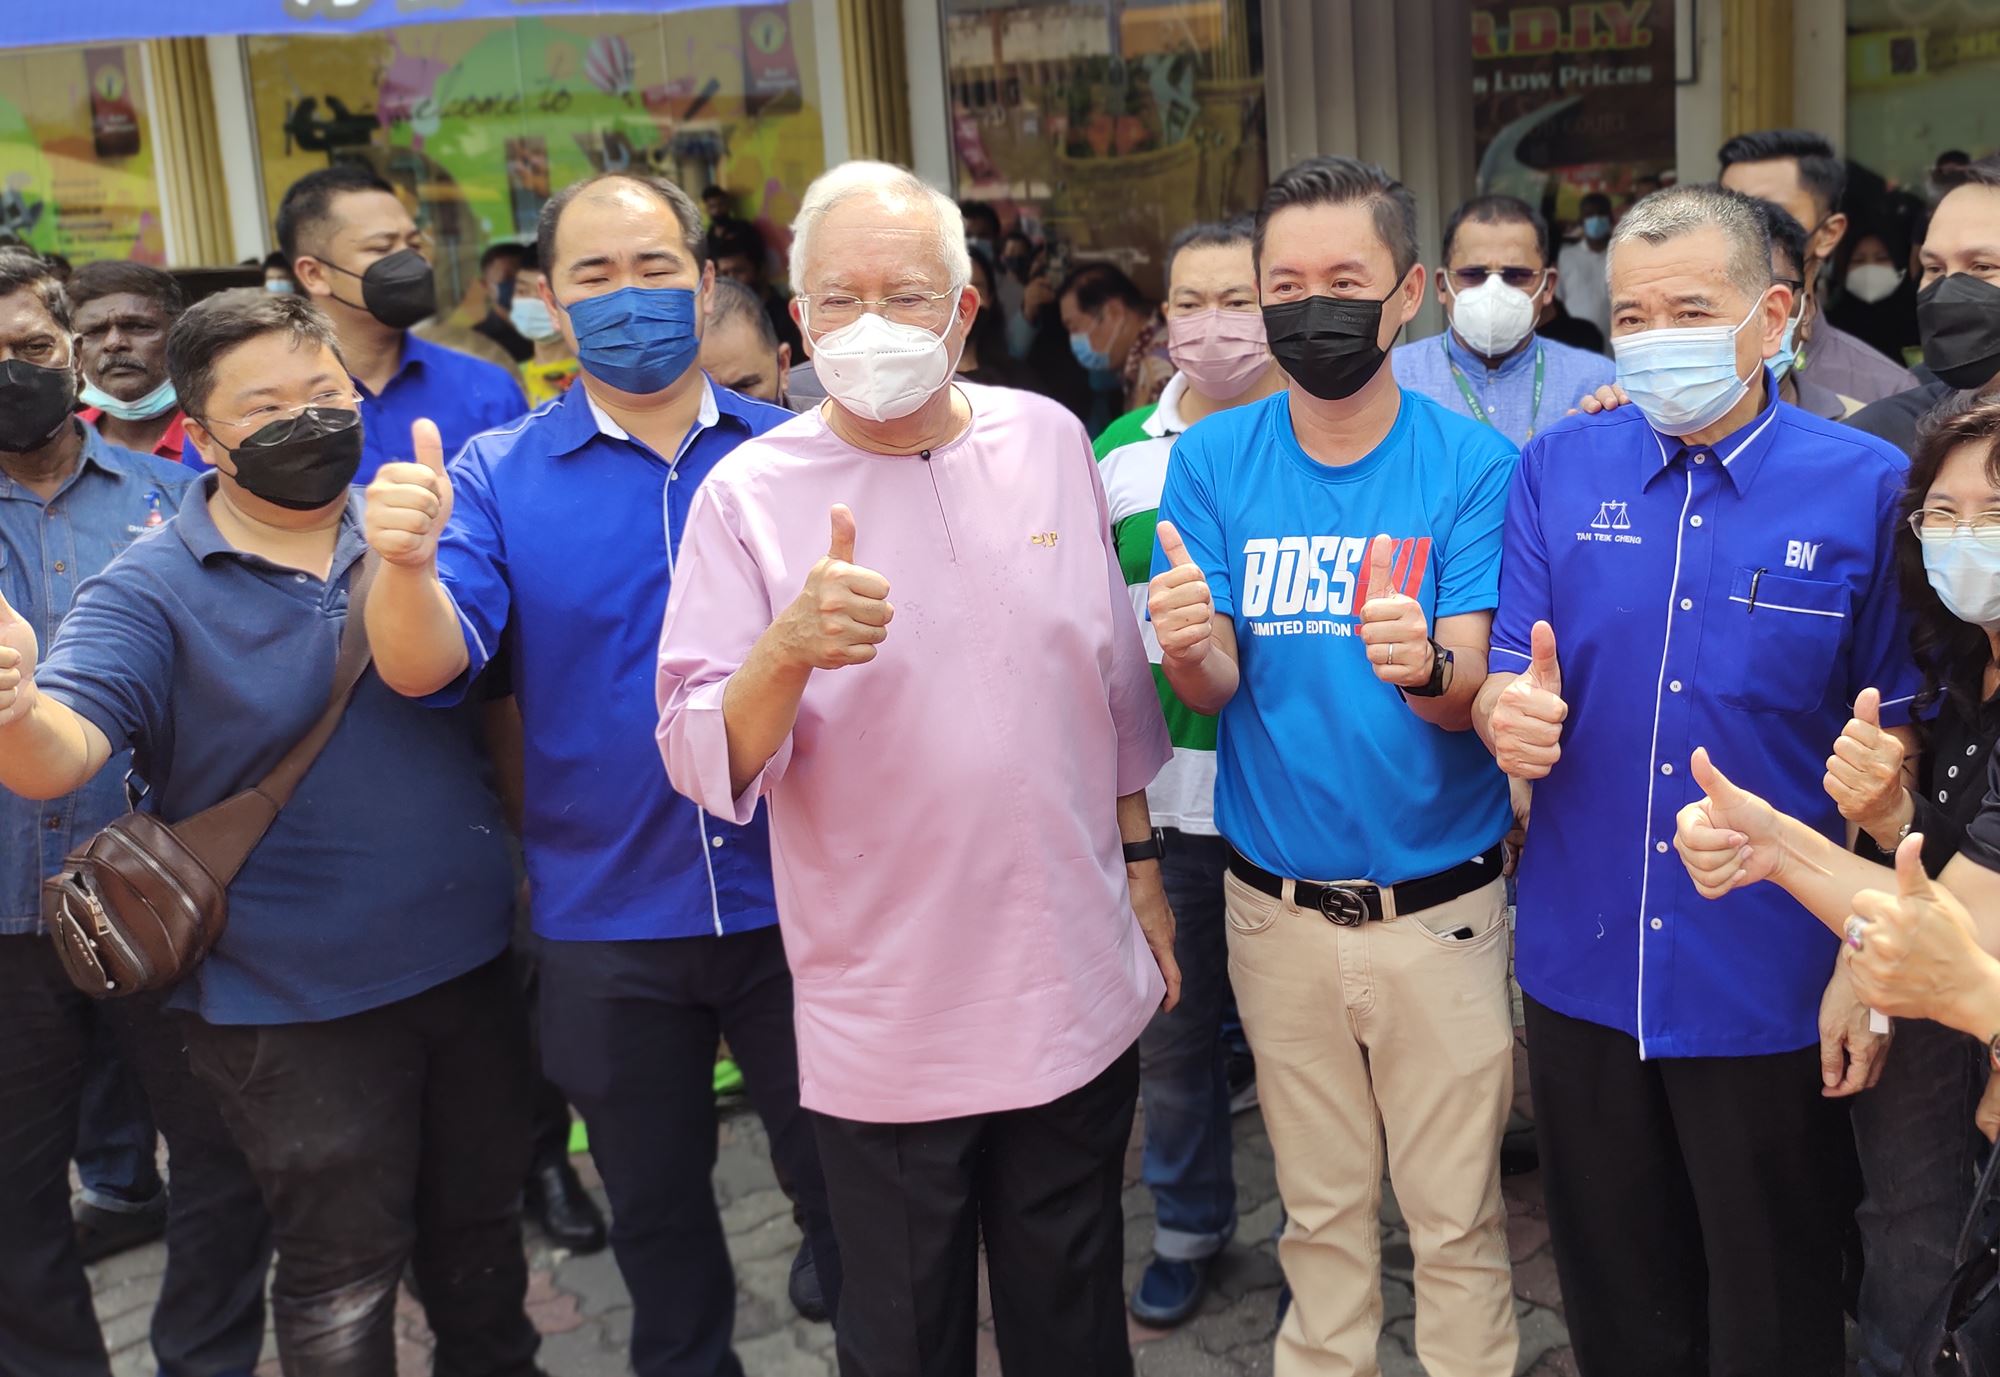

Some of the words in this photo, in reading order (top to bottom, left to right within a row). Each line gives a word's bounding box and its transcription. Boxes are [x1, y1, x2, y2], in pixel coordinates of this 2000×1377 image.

[1494, 70, 1550, 92] Low
[1559, 65, 1652, 88] Prices
[1576, 532, 1592, 541] TAN
[1784, 539, 1818, 571] BN
[1250, 620, 1303, 637] LIMITED
[1306, 620, 1351, 637] EDITION
